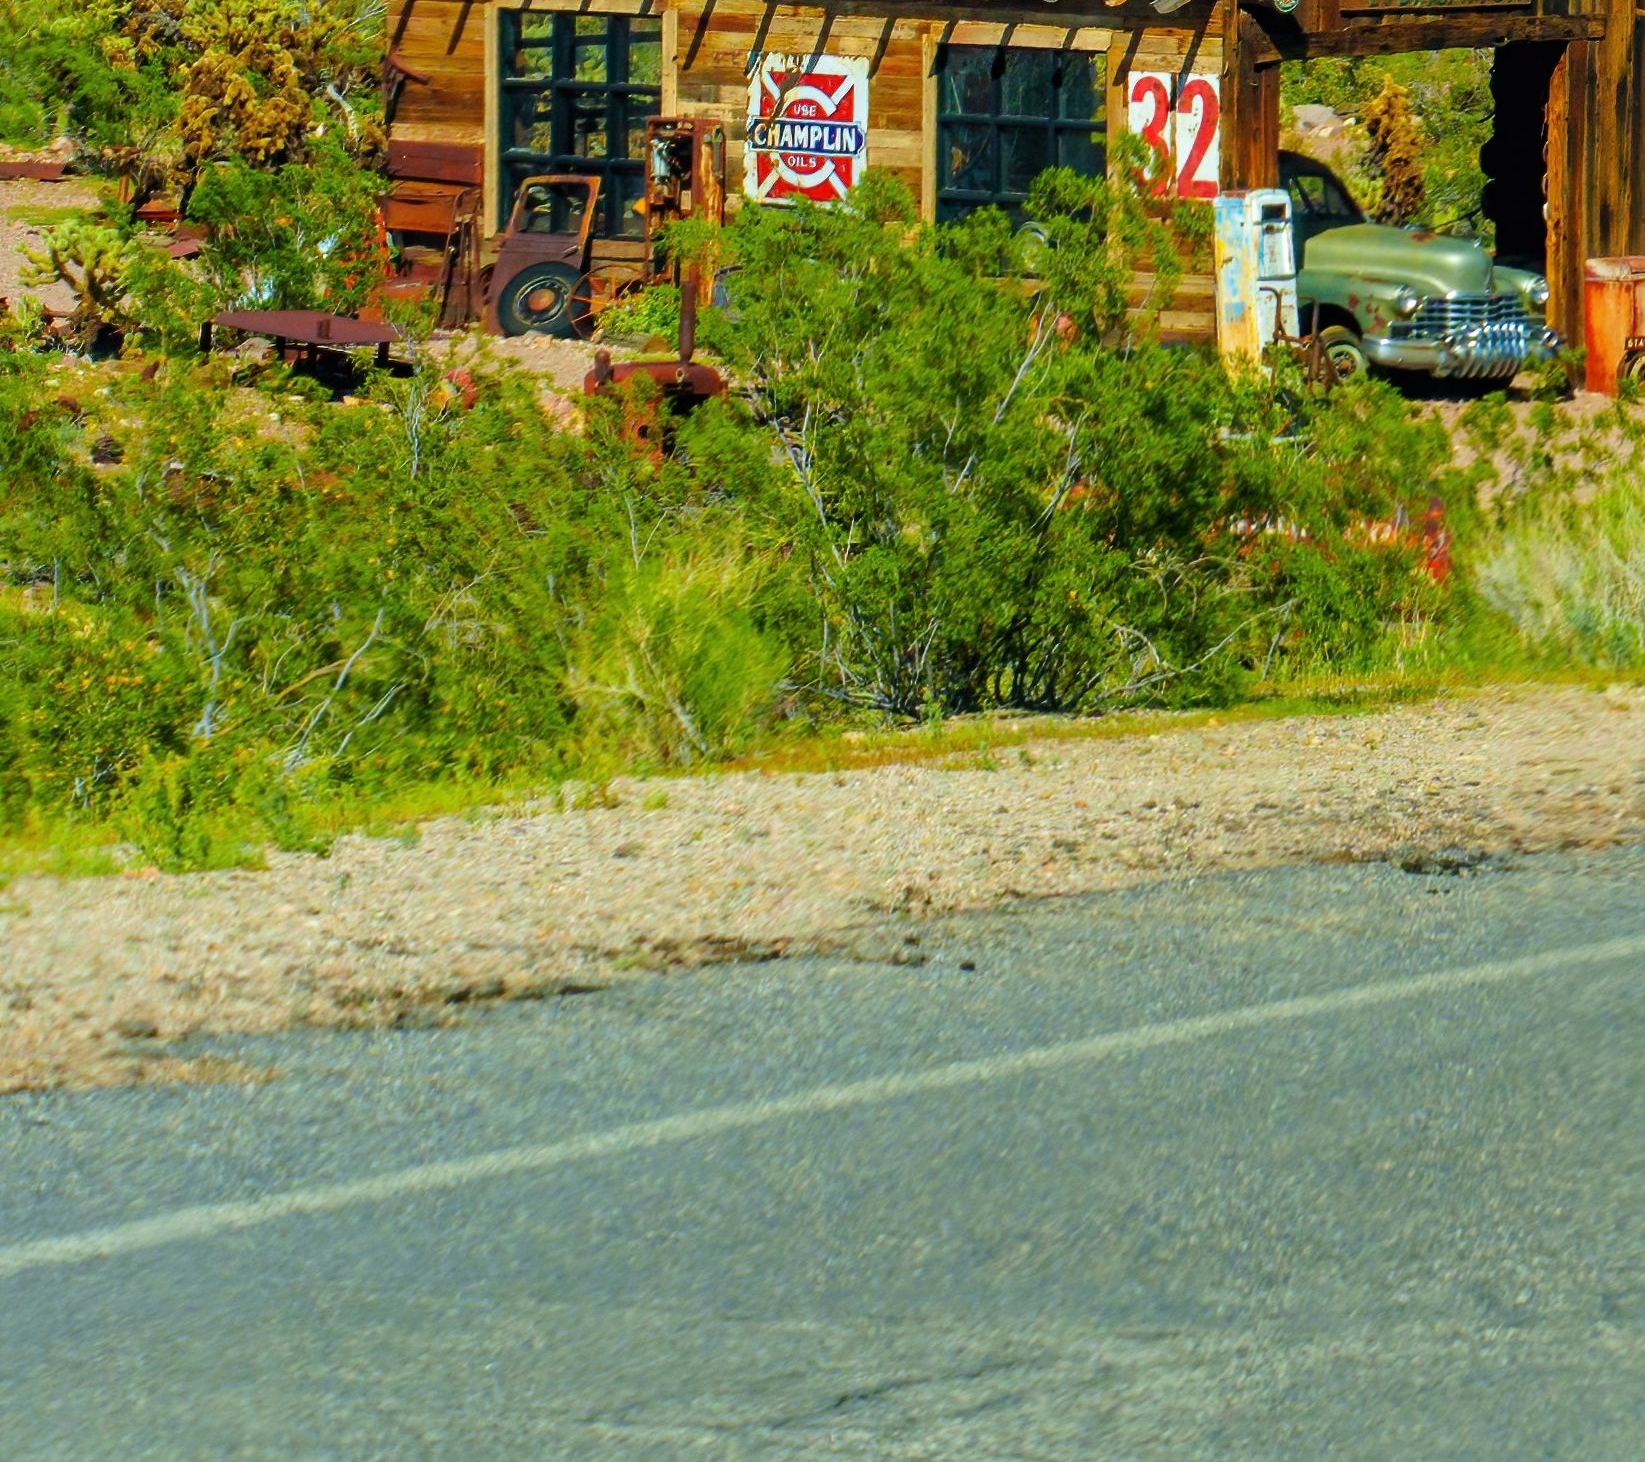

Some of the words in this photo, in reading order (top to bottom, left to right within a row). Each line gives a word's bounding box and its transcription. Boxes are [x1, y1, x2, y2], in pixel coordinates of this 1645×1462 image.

[793, 104, 817, 117] USE
[754, 123, 856, 152] CHAMPLIN
[1131, 75, 1220, 200] 32
[787, 155, 817, 169] OILS
